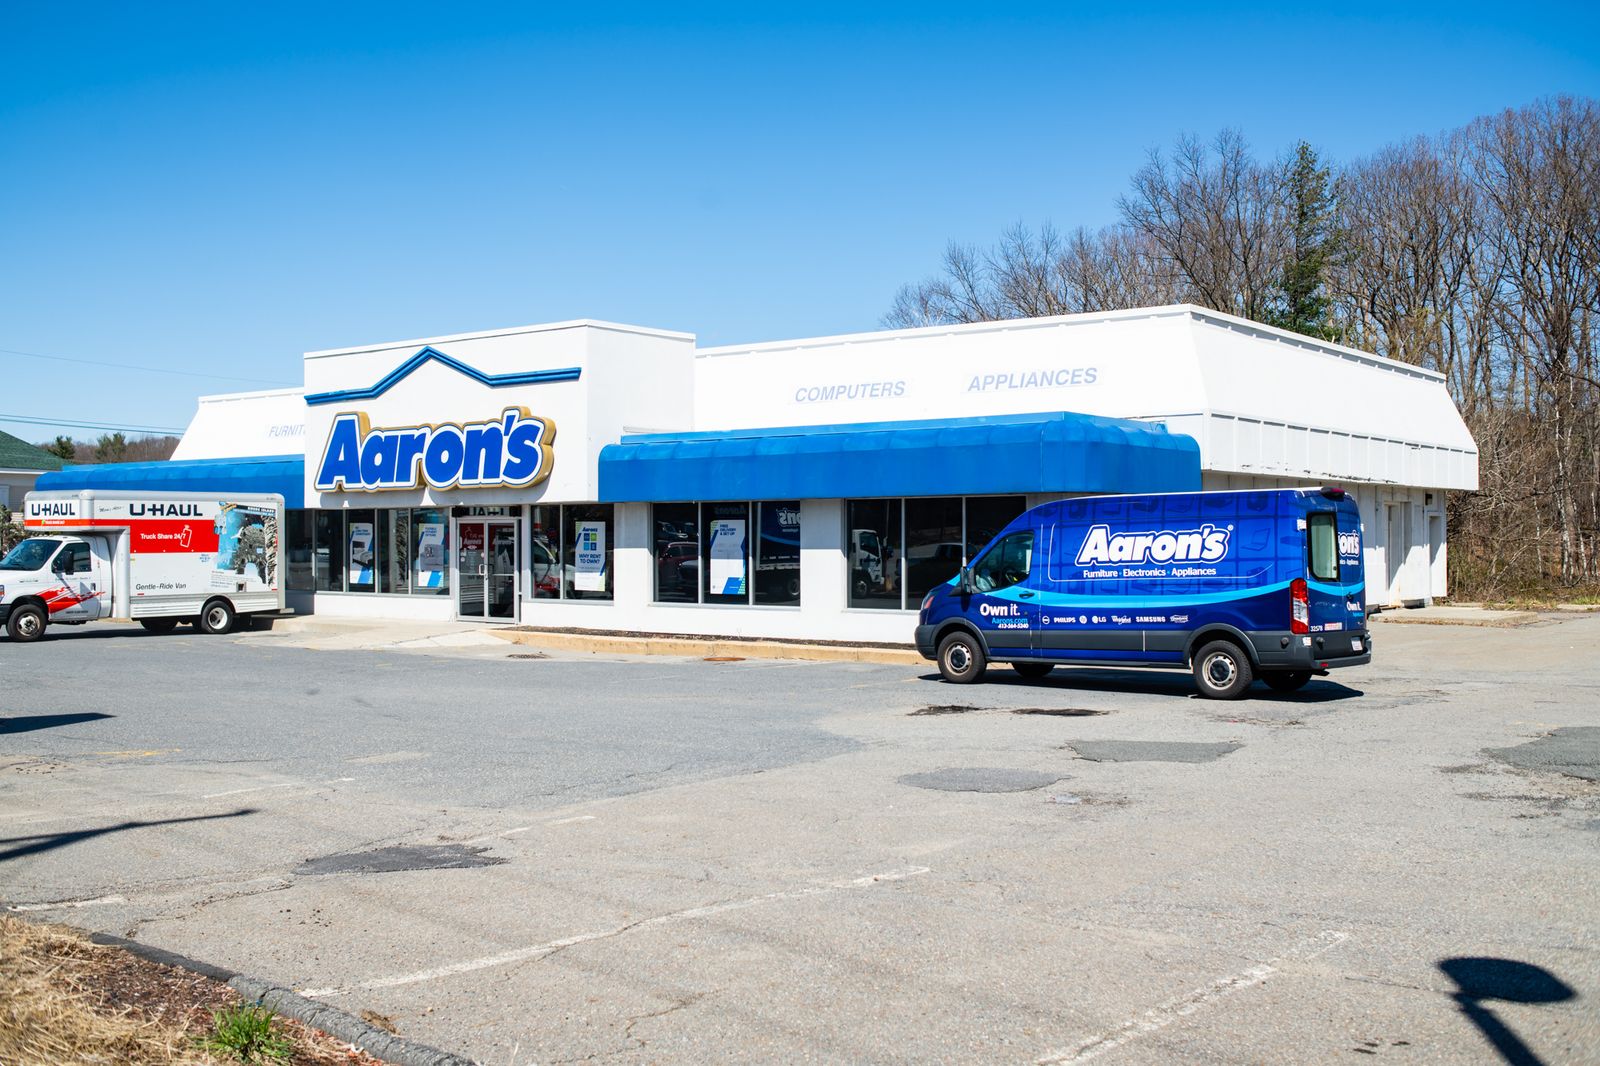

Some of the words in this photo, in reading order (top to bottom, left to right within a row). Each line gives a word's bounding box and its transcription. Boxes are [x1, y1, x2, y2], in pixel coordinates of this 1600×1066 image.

[967, 367, 1098, 391] APPLIANCES
[795, 381, 906, 402] COMPUTERS
[269, 424, 306, 437] FURNIT
[315, 411, 545, 488] Aaron's
[31, 503, 75, 516] U-HAUL
[129, 503, 203, 516] U-HAUL
[1075, 524, 1229, 566] Aaron's
[1083, 569, 1118, 578] Furniture
[1123, 569, 1166, 577] Electronics
[1171, 567, 1217, 577] Appliances
[980, 603, 1008, 616] Own
[1010, 603, 1020, 616] it.
